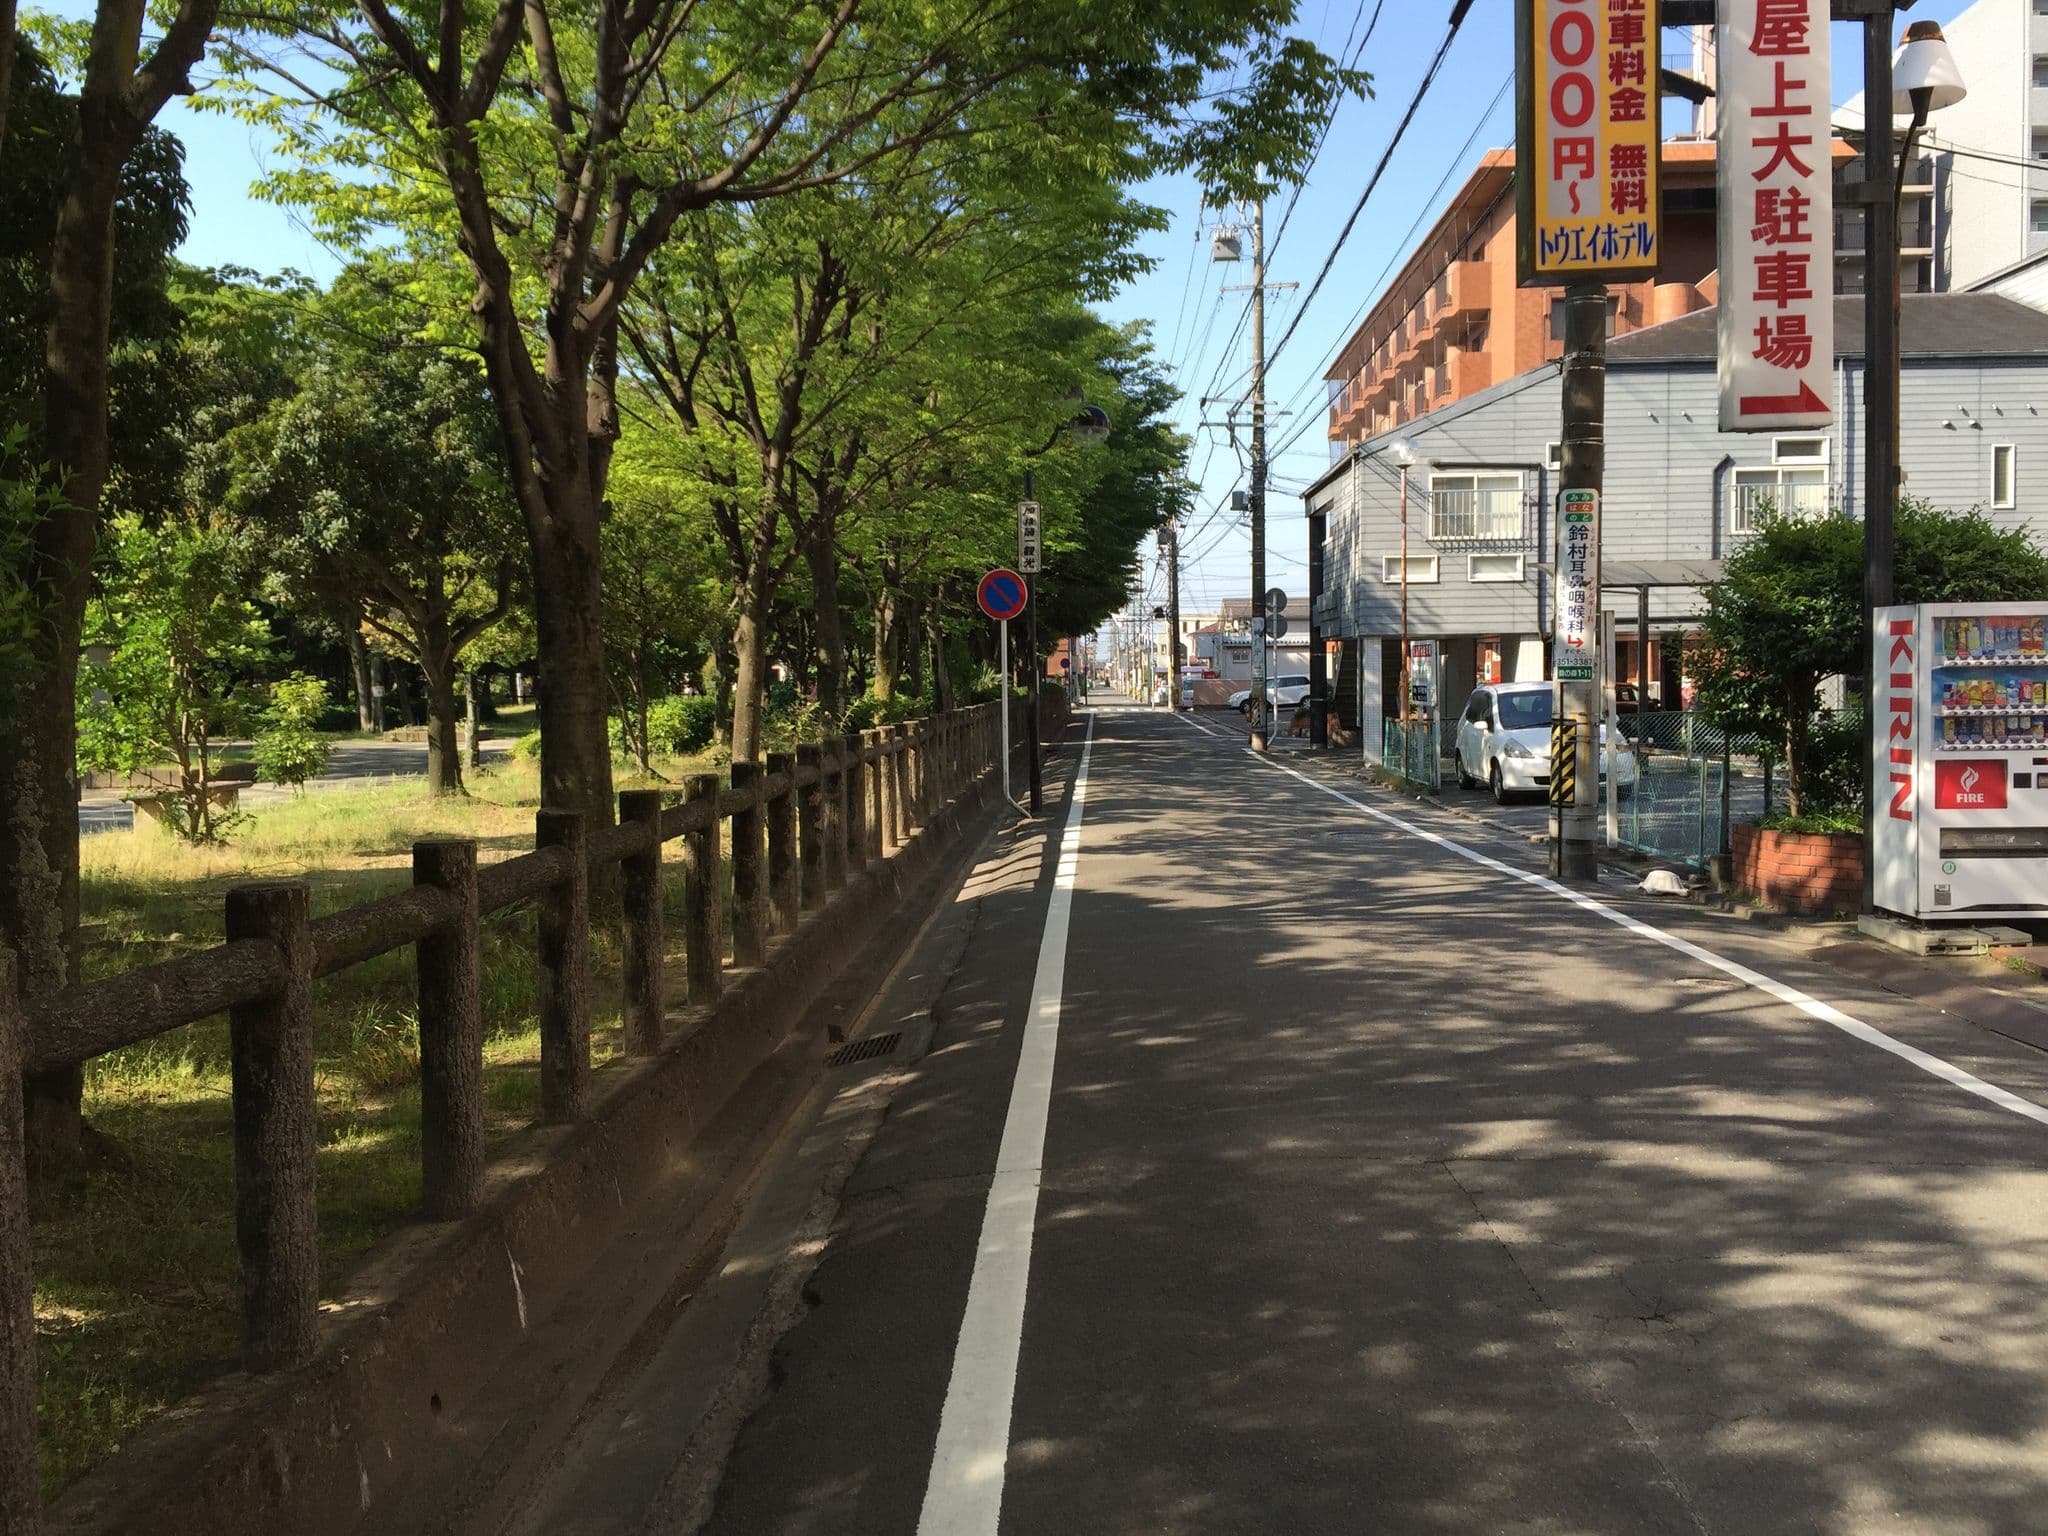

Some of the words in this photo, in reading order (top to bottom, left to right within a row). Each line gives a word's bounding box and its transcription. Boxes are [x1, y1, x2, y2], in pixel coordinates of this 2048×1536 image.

[1609, 144, 1648, 215] 無料
[1748, 0, 1815, 370] 屋上大駐車場
[1540, 221, 1655, 267] トウエイホテル
[1567, 524, 1589, 634] 鈴村耳鼻咽喉科
[1888, 619, 1914, 822] KIRIN
[1955, 792, 1985, 804] FIRE
